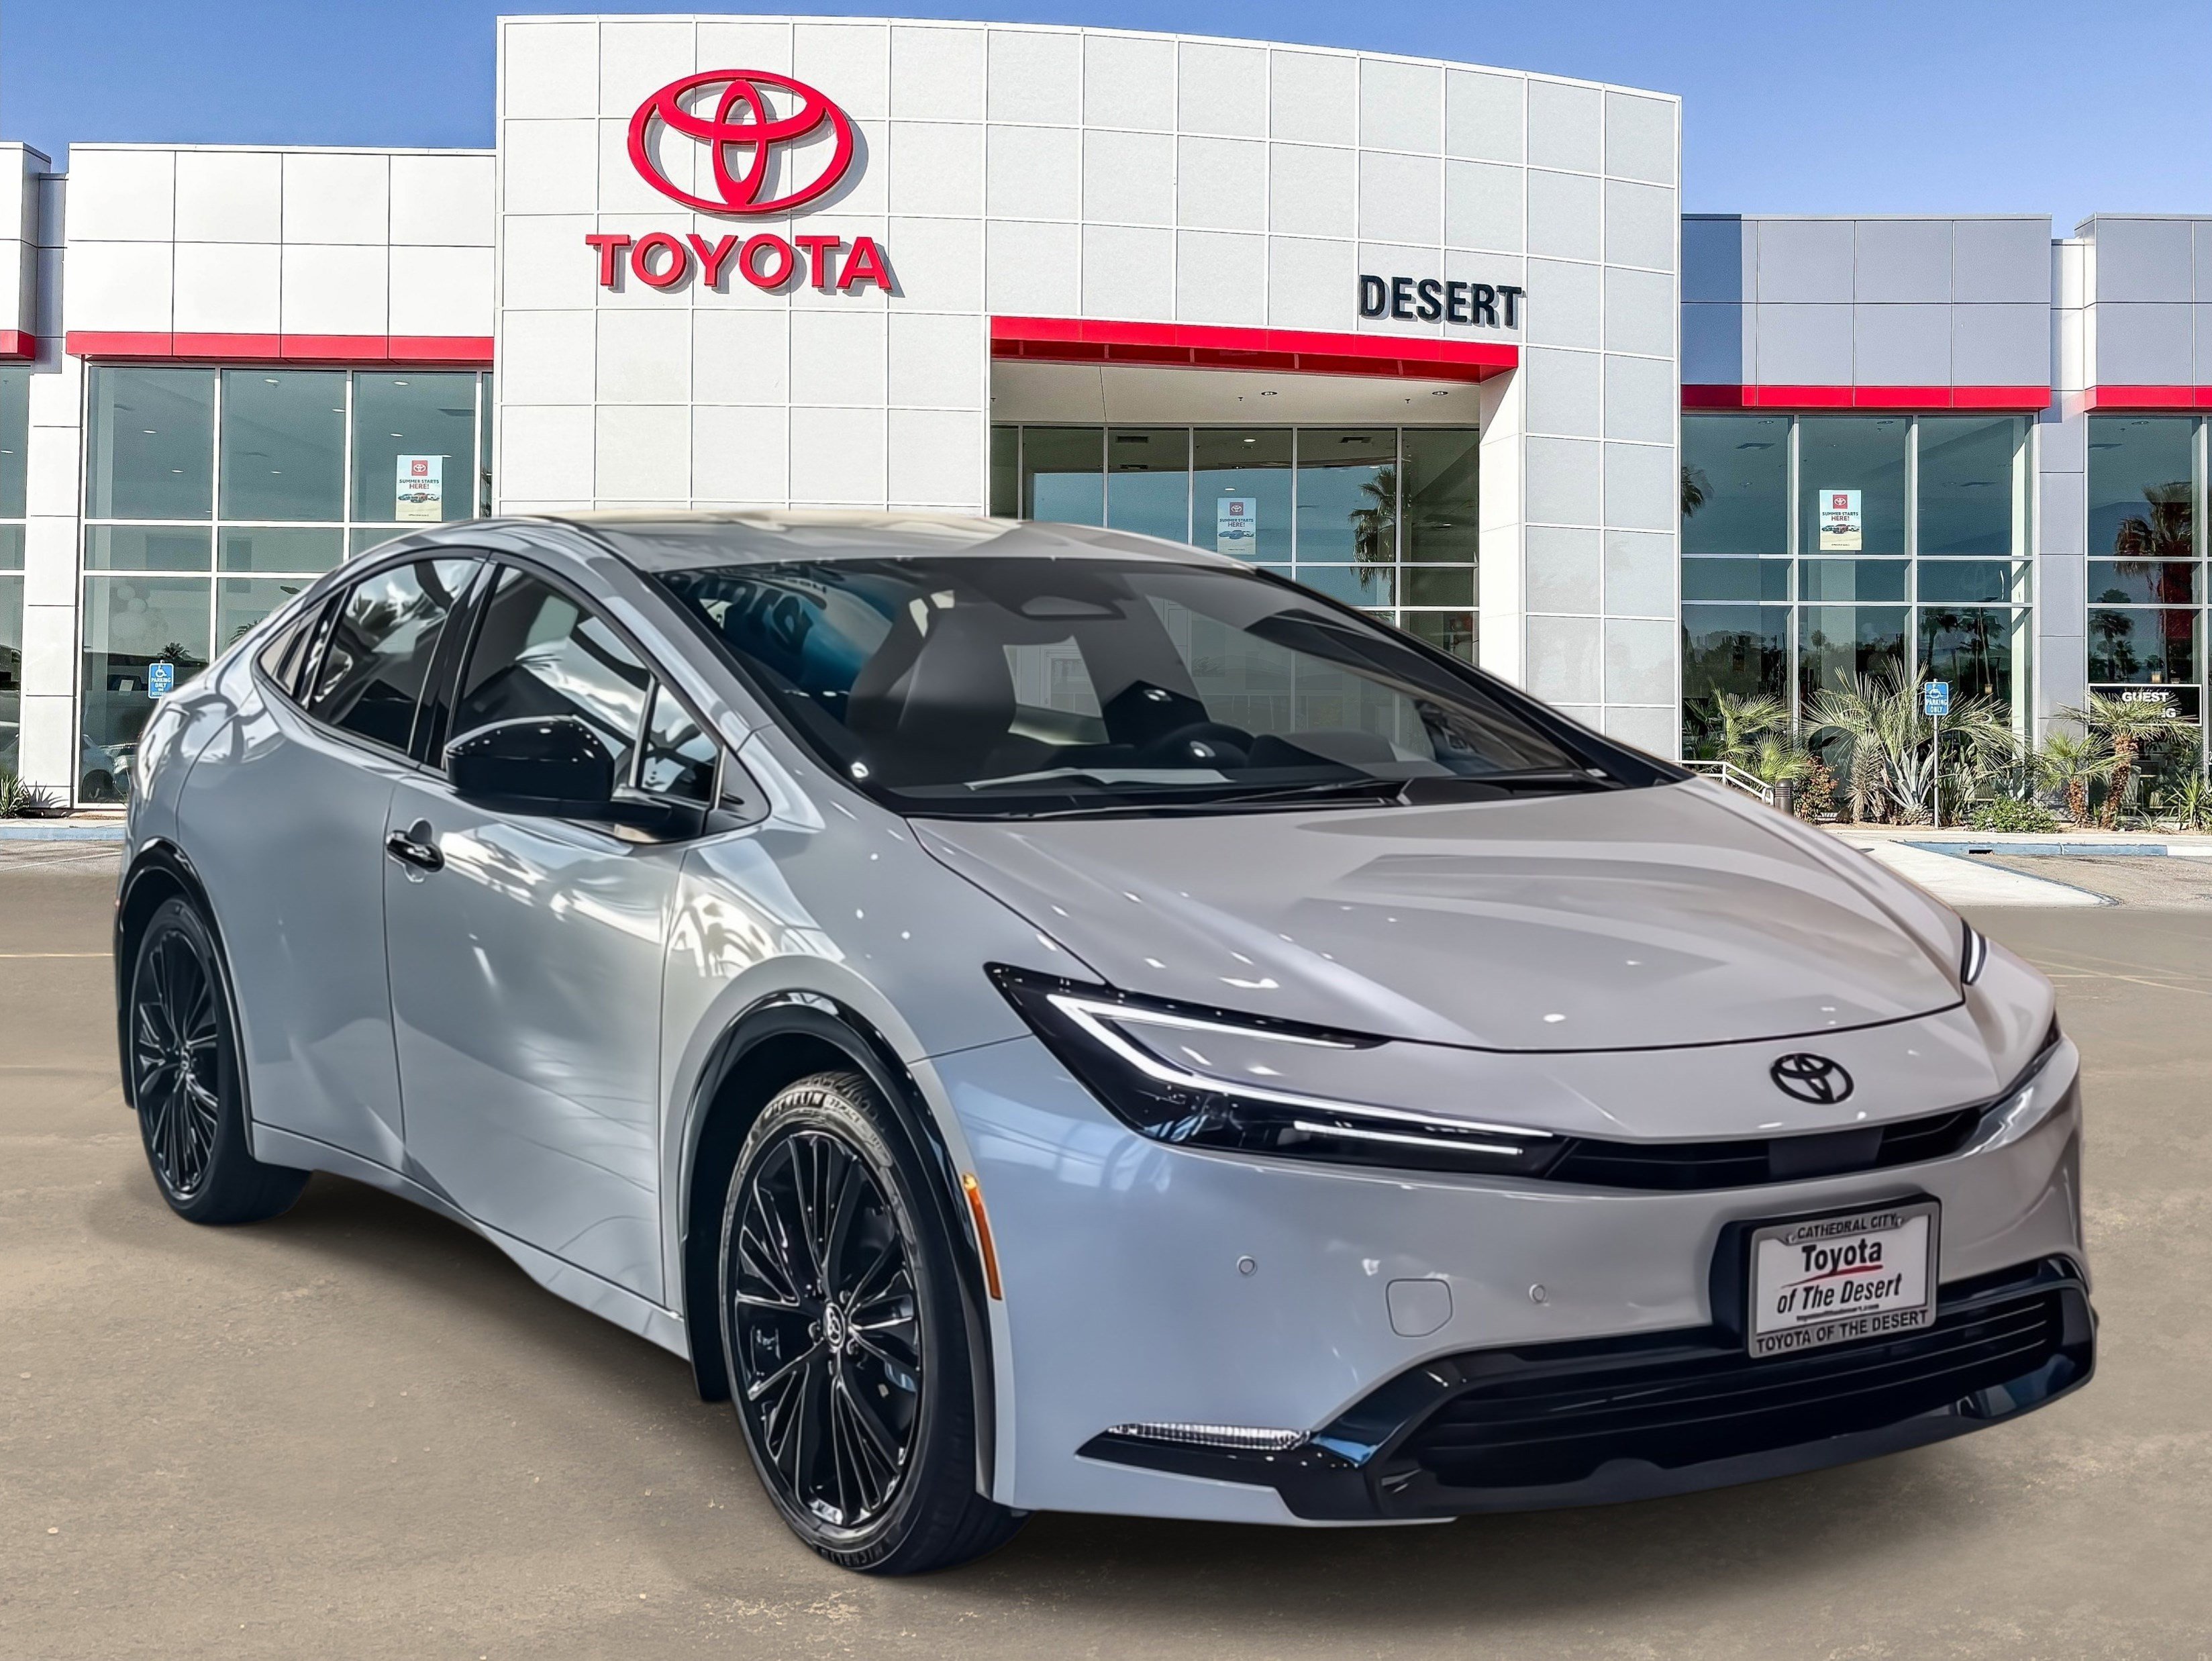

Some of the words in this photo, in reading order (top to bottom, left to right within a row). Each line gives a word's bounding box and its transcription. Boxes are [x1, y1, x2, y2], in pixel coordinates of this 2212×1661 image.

[585, 232, 892, 290] TOYOTA
[1358, 274, 1522, 326] DESERT
[2121, 692, 2169, 702] GUEST
[1797, 1218, 1866, 1240] CATHEDRAL
[1870, 1213, 1897, 1229] CITY
[1802, 1238, 1882, 1274] Toyota
[1777, 1286, 1798, 1314] of
[1803, 1284, 1835, 1310] The
[1840, 1273, 1903, 1304] Desert
[1757, 1331, 1811, 1353] TOYOTA
[1817, 1326, 1835, 1342] OF
[1840, 1317, 1867, 1337] THE
[1872, 1309, 1928, 1331] DESERT
